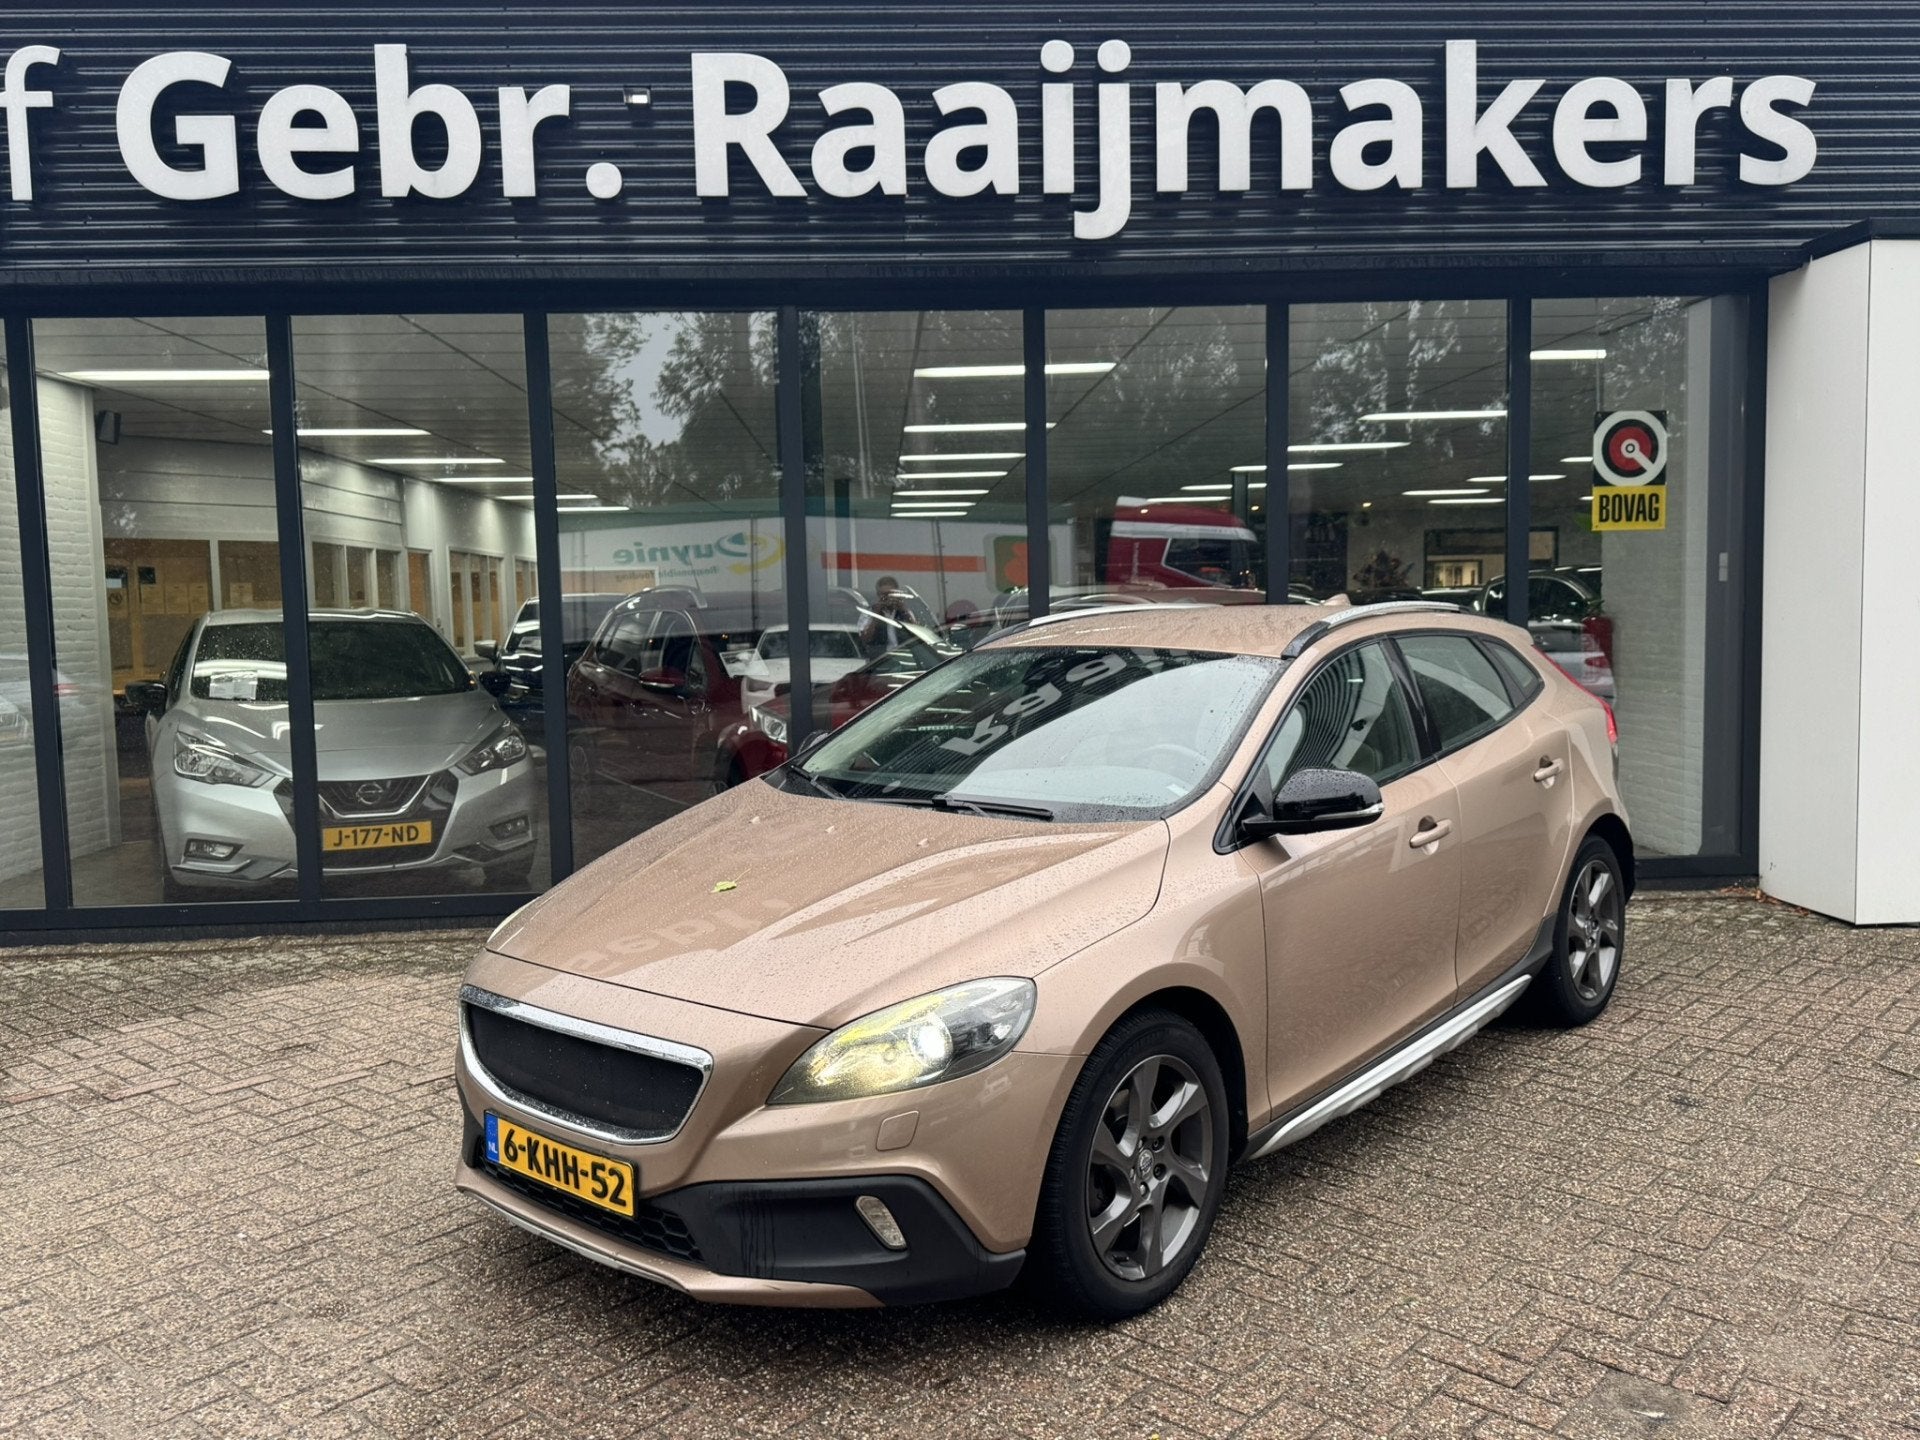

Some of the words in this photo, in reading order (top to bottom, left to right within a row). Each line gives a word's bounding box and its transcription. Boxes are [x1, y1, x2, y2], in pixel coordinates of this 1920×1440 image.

[116, 43, 623, 201] Gebr.
[690, 38, 1818, 240] Raaijmakers
[1598, 492, 1660, 523] BOVAG
[333, 825, 419, 847] J-177-ND
[488, 1141, 498, 1154] NL
[503, 1128, 628, 1207] 6-KHH-52
